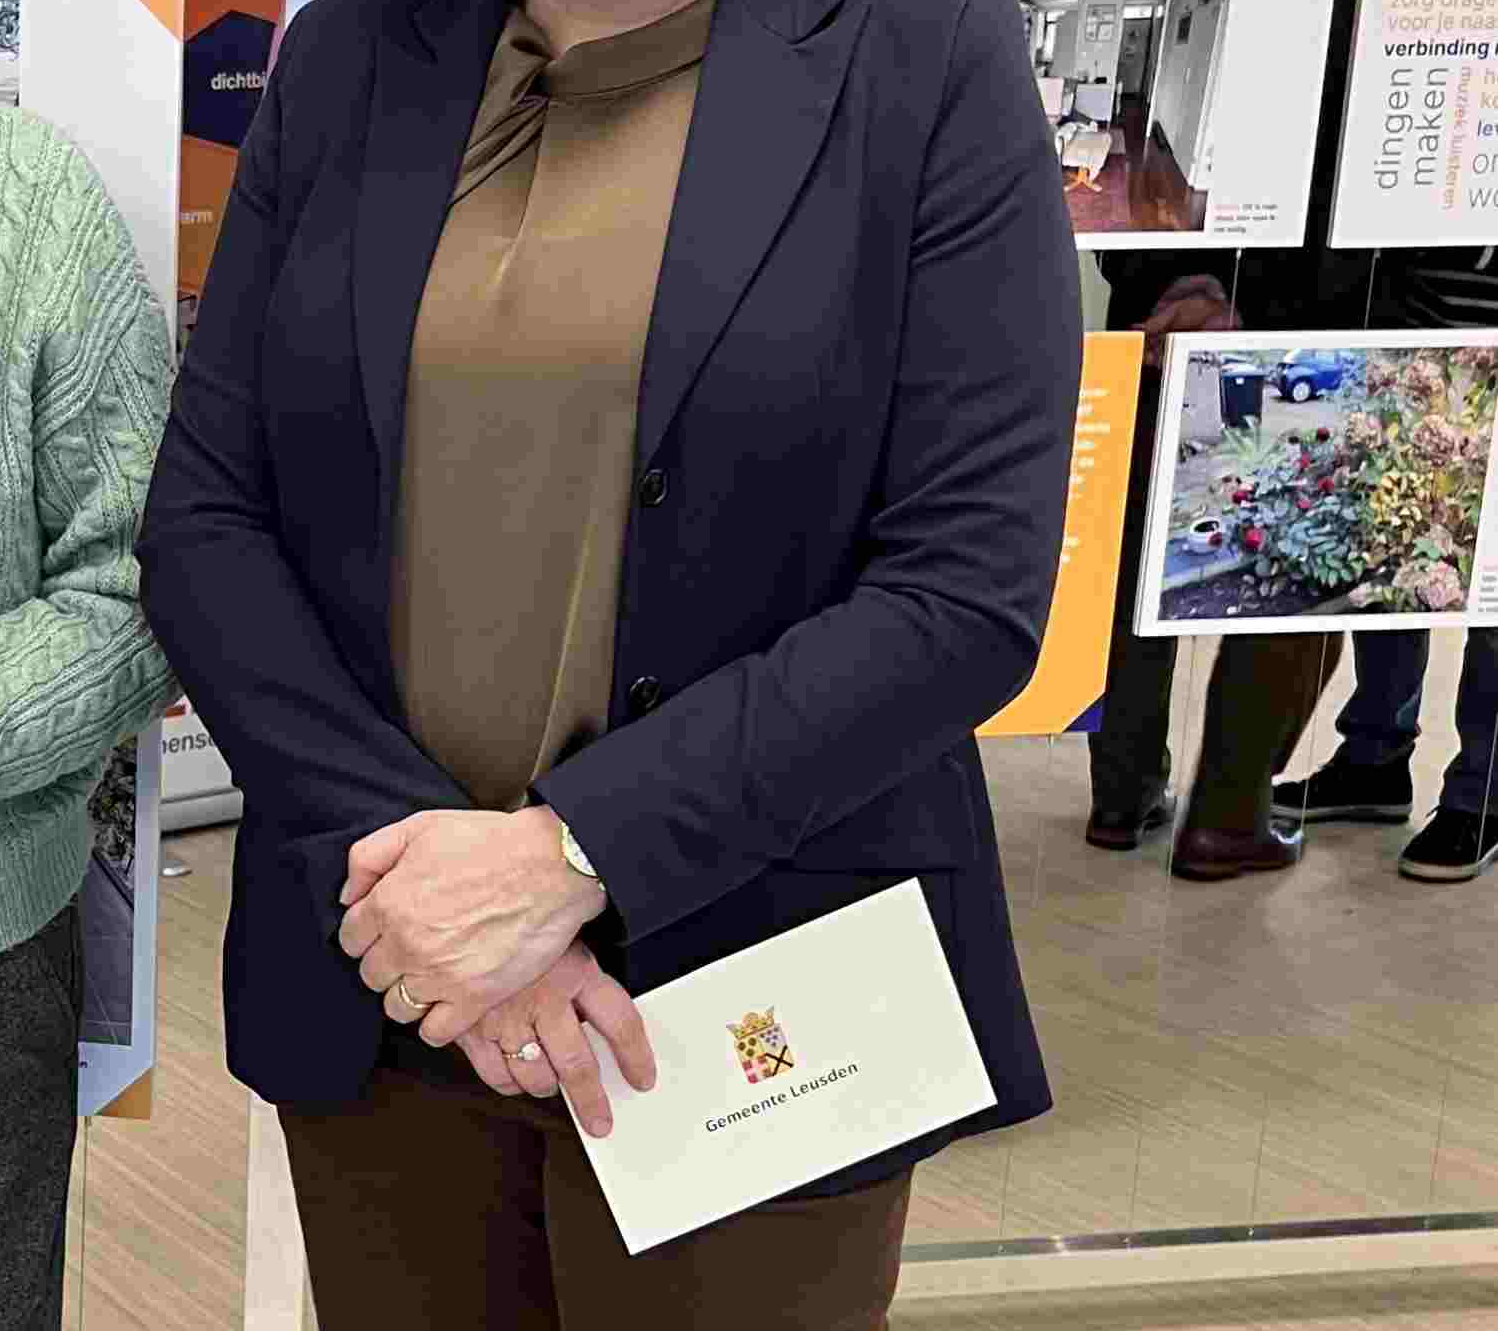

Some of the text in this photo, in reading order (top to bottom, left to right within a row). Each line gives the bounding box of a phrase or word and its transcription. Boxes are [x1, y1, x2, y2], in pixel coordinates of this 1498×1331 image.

[1384, 37, 1490, 60] verbinding
[1389, 13, 1498, 34] voor je naa
[1374, 68, 1414, 189] dingen
[1413, 68, 1449, 185] maken
[705, 1063, 859, 1132] Gemeente Leusden
